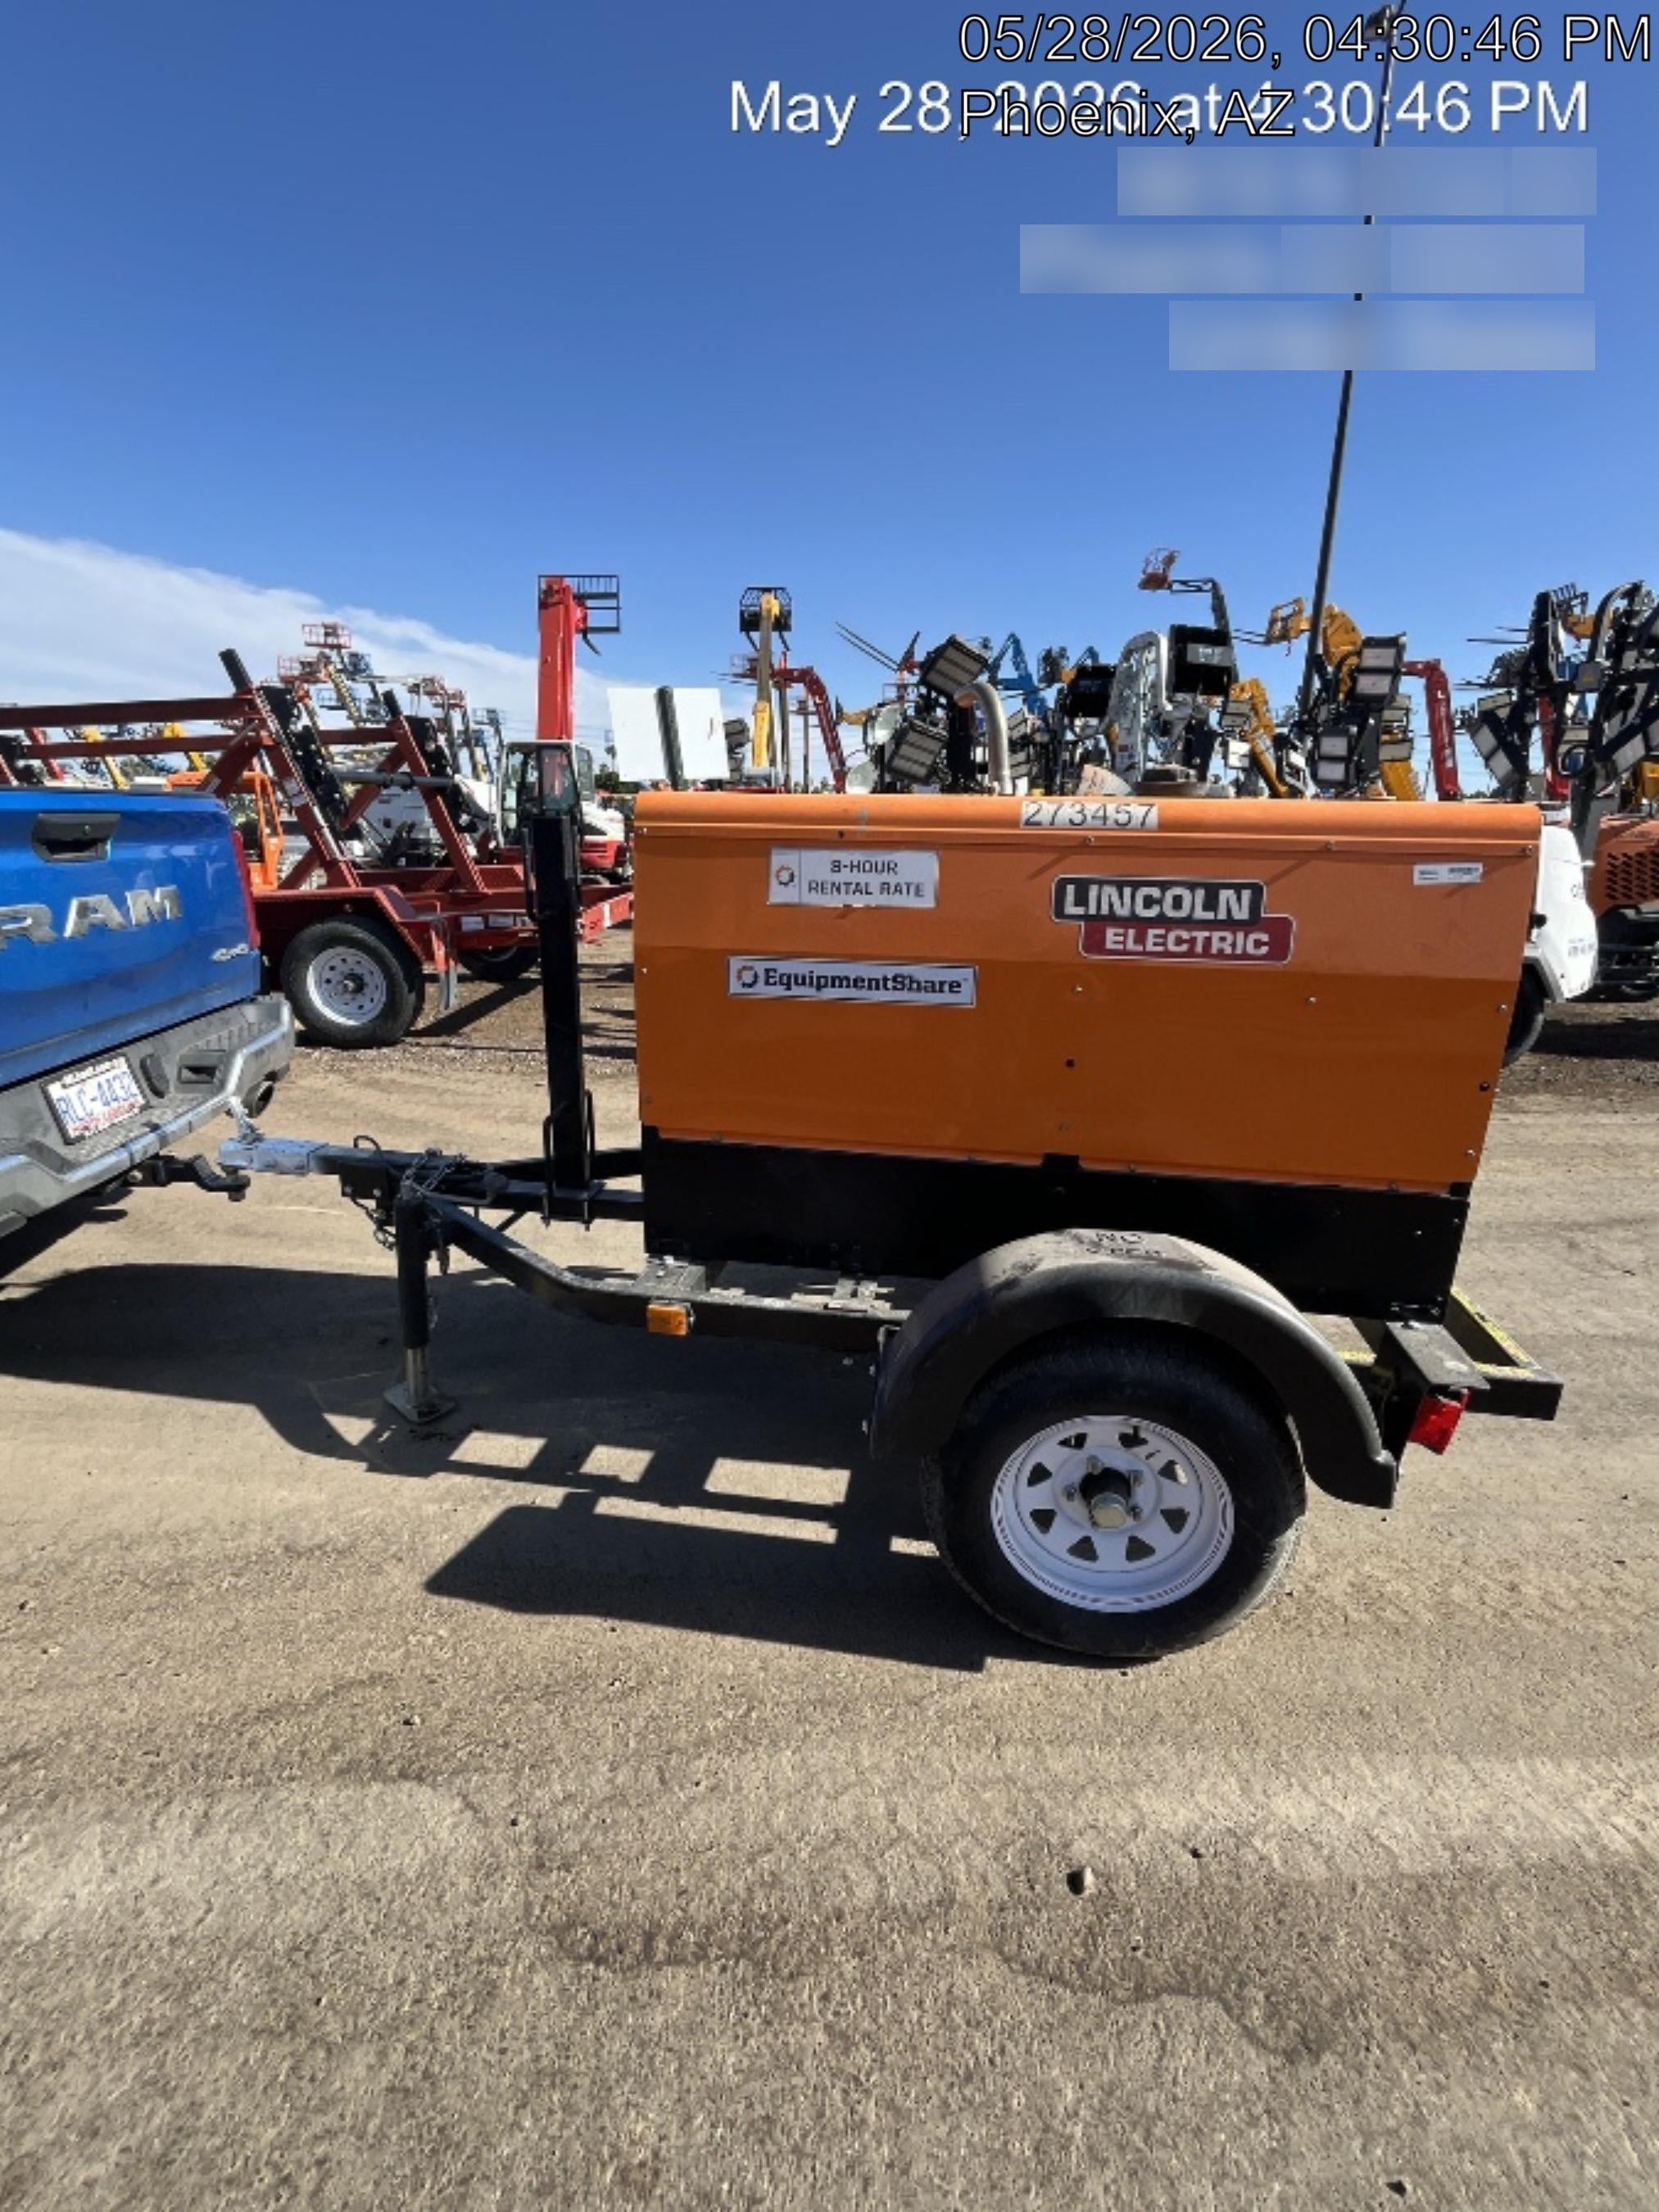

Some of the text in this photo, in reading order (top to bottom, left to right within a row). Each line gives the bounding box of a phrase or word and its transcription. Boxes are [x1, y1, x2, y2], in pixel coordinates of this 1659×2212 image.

[1023, 802, 1155, 827] 273457
[830, 859, 899, 876] 8-HOUR
[807, 880, 926, 898] RENTAL RATE
[1063, 884, 1253, 920] LINCOLN
[0, 885, 182, 950] RAM
[1105, 928, 1270, 955] ELECTRIC
[763, 967, 963, 995] EquipmentShare
